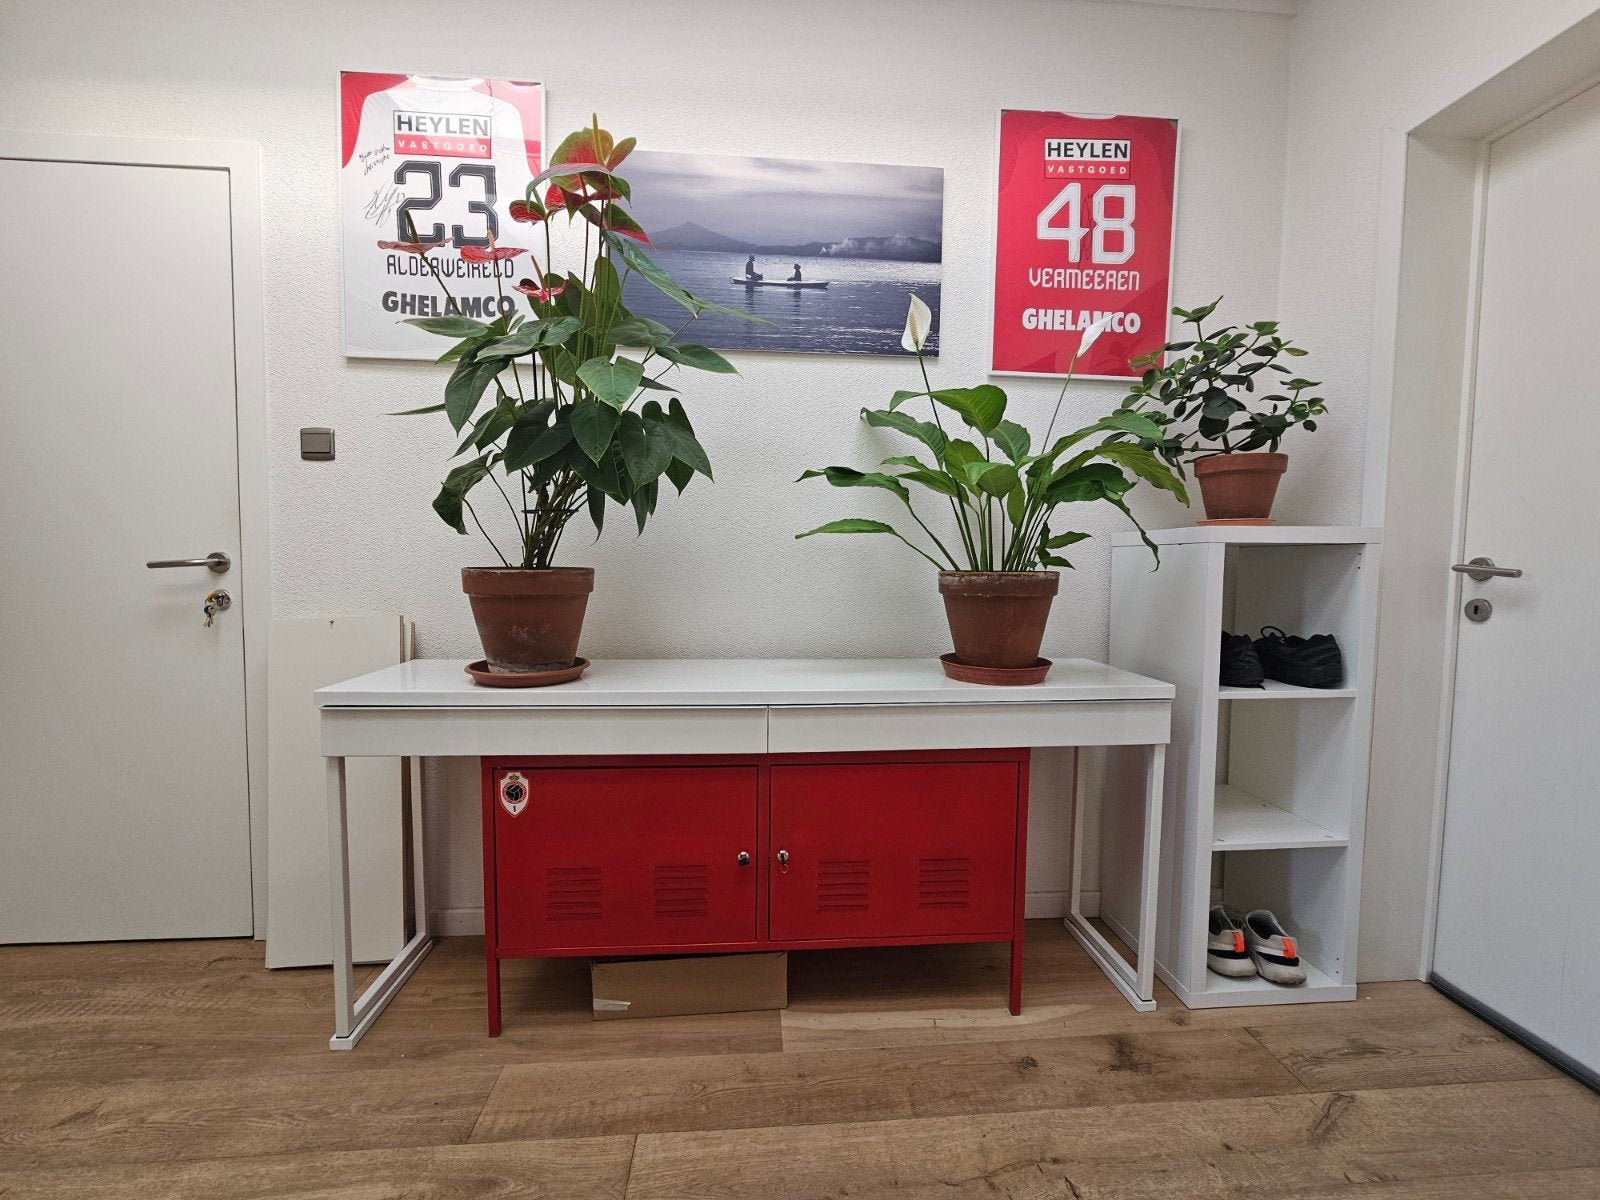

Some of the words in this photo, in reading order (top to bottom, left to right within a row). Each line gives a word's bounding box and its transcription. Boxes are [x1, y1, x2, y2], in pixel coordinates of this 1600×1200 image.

[396, 112, 489, 137] HEYLEN
[397, 140, 487, 153] VASTGOED
[1047, 141, 1128, 159] HEYLEN
[1047, 165, 1127, 175] VASTGOED
[393, 160, 499, 249] 23
[1037, 182, 1136, 264] 48
[386, 254, 514, 279] ALDERWEIRELD
[1028, 267, 1140, 291] VERMEEREN
[381, 290, 516, 319] GHELAMCO
[1022, 308, 1141, 334] GHELAMCO
